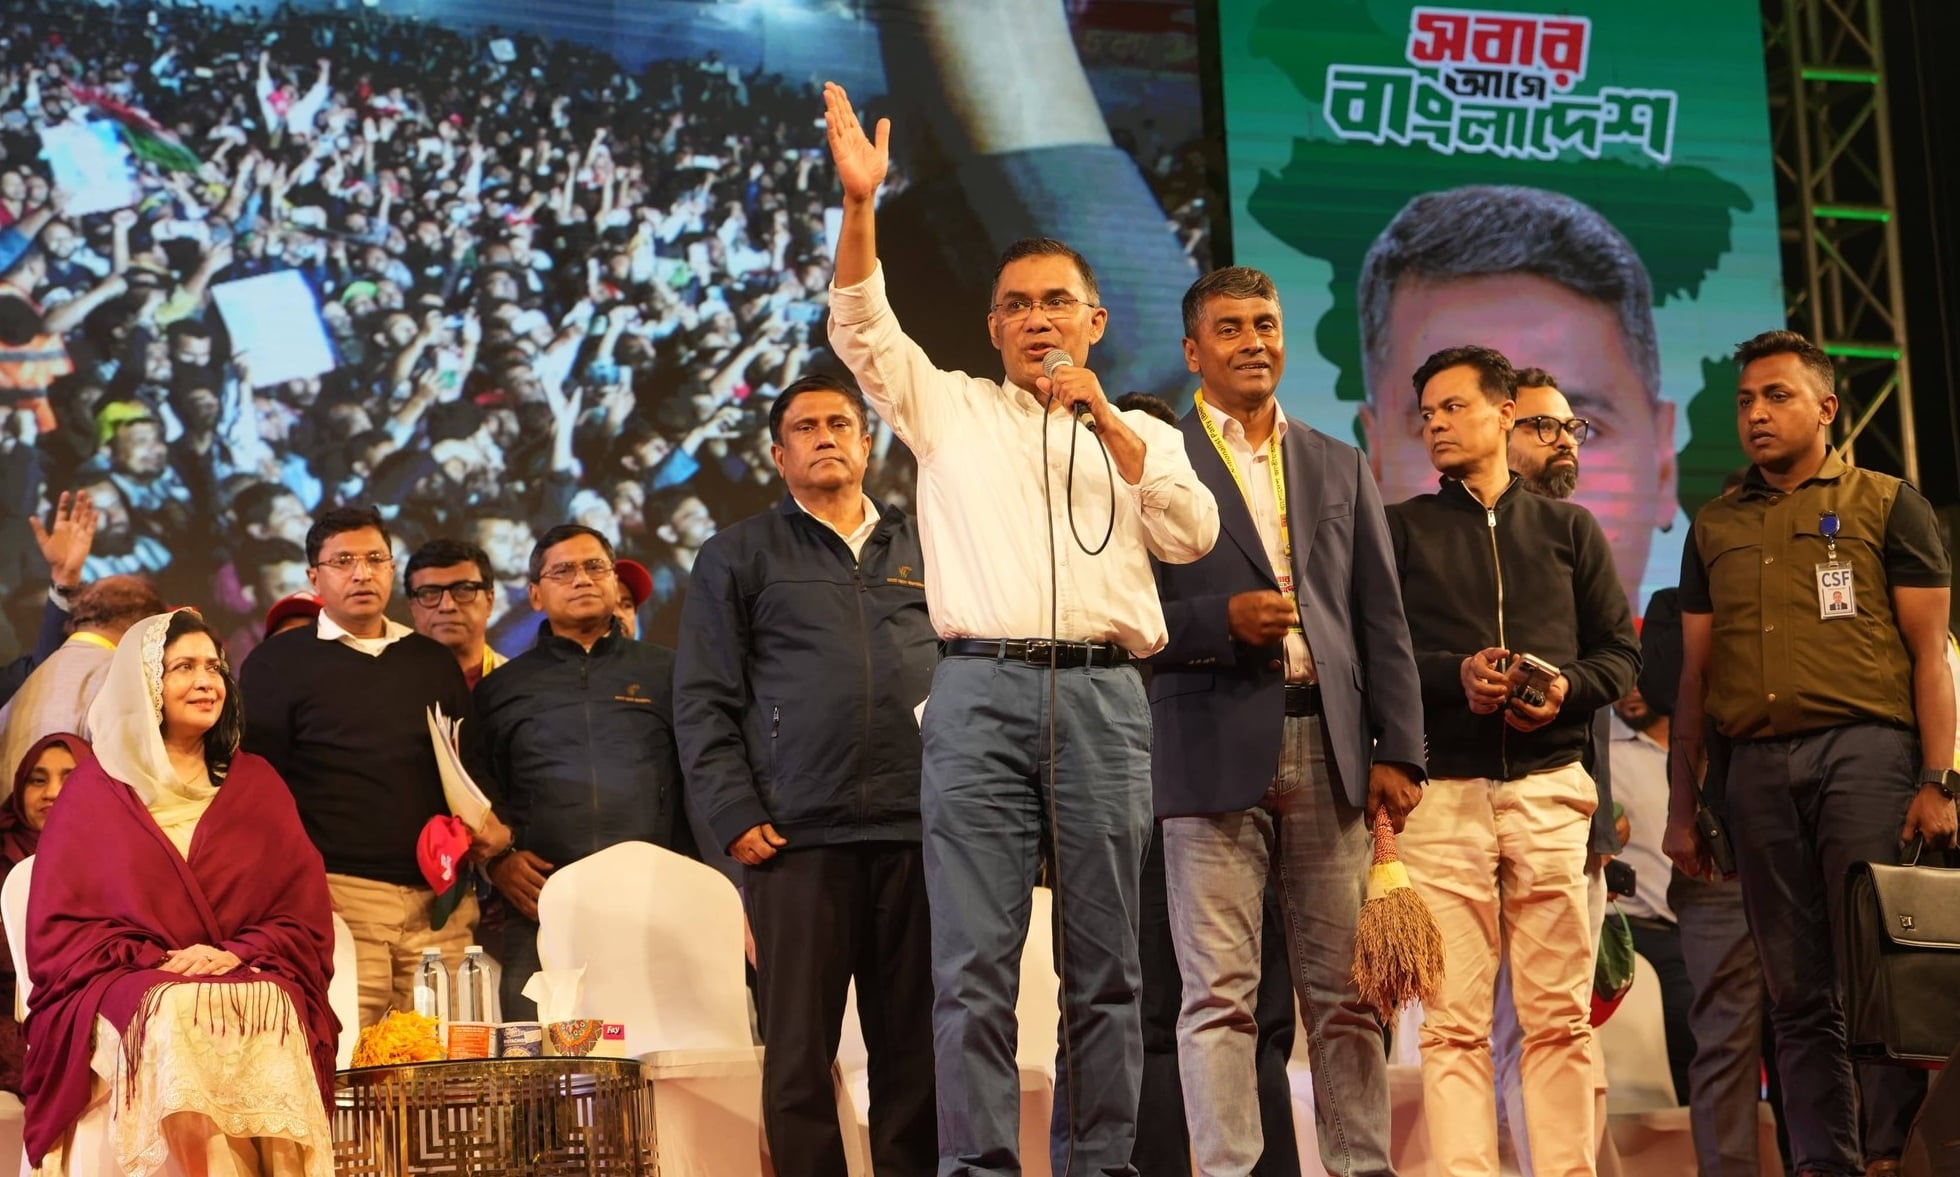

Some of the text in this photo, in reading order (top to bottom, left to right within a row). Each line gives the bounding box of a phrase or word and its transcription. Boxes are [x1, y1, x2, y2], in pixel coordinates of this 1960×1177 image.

[1410, 11, 1588, 90] সবার
[1445, 67, 1547, 101] আগে
[1326, 67, 1677, 161] বাংলাদেশ
[1821, 571, 1849, 587] CSF
